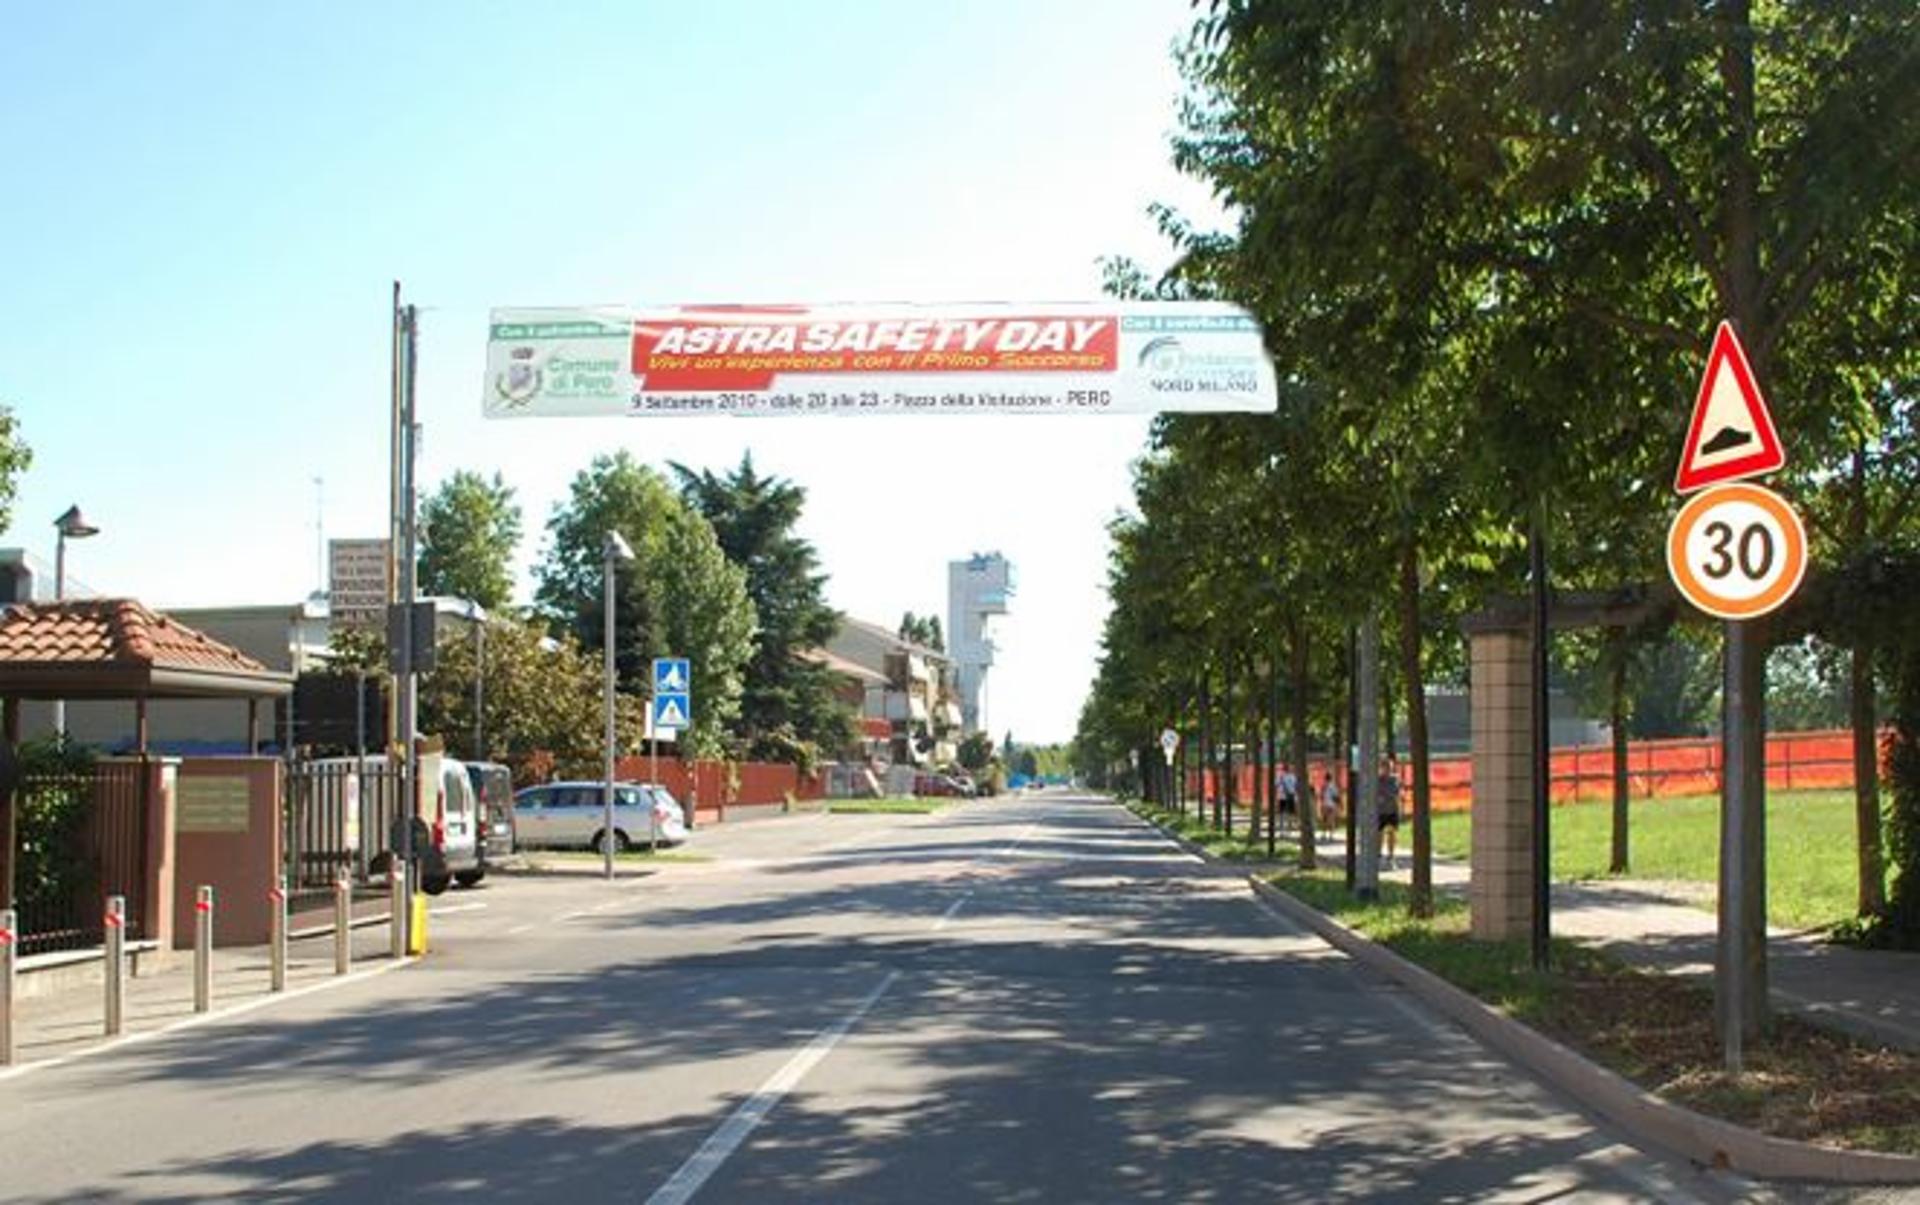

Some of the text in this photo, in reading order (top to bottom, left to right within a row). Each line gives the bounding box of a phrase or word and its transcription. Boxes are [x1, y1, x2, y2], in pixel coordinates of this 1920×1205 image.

[653, 320, 1107, 354] ASTRA SAFETY DAY
[650, 355, 687, 369] Vivi
[853, 354, 892, 368] con
[900, 353, 917, 367] il
[922, 352, 990, 367] Primo
[998, 352, 1108, 367] Soccorso
[1150, 378, 1259, 394] NORD MILANO
[717, 393, 756, 409] 2010
[808, 392, 827, 408] 20
[859, 391, 879, 408] 23
[941, 391, 975, 407] della
[1703, 521, 1774, 580] 30
